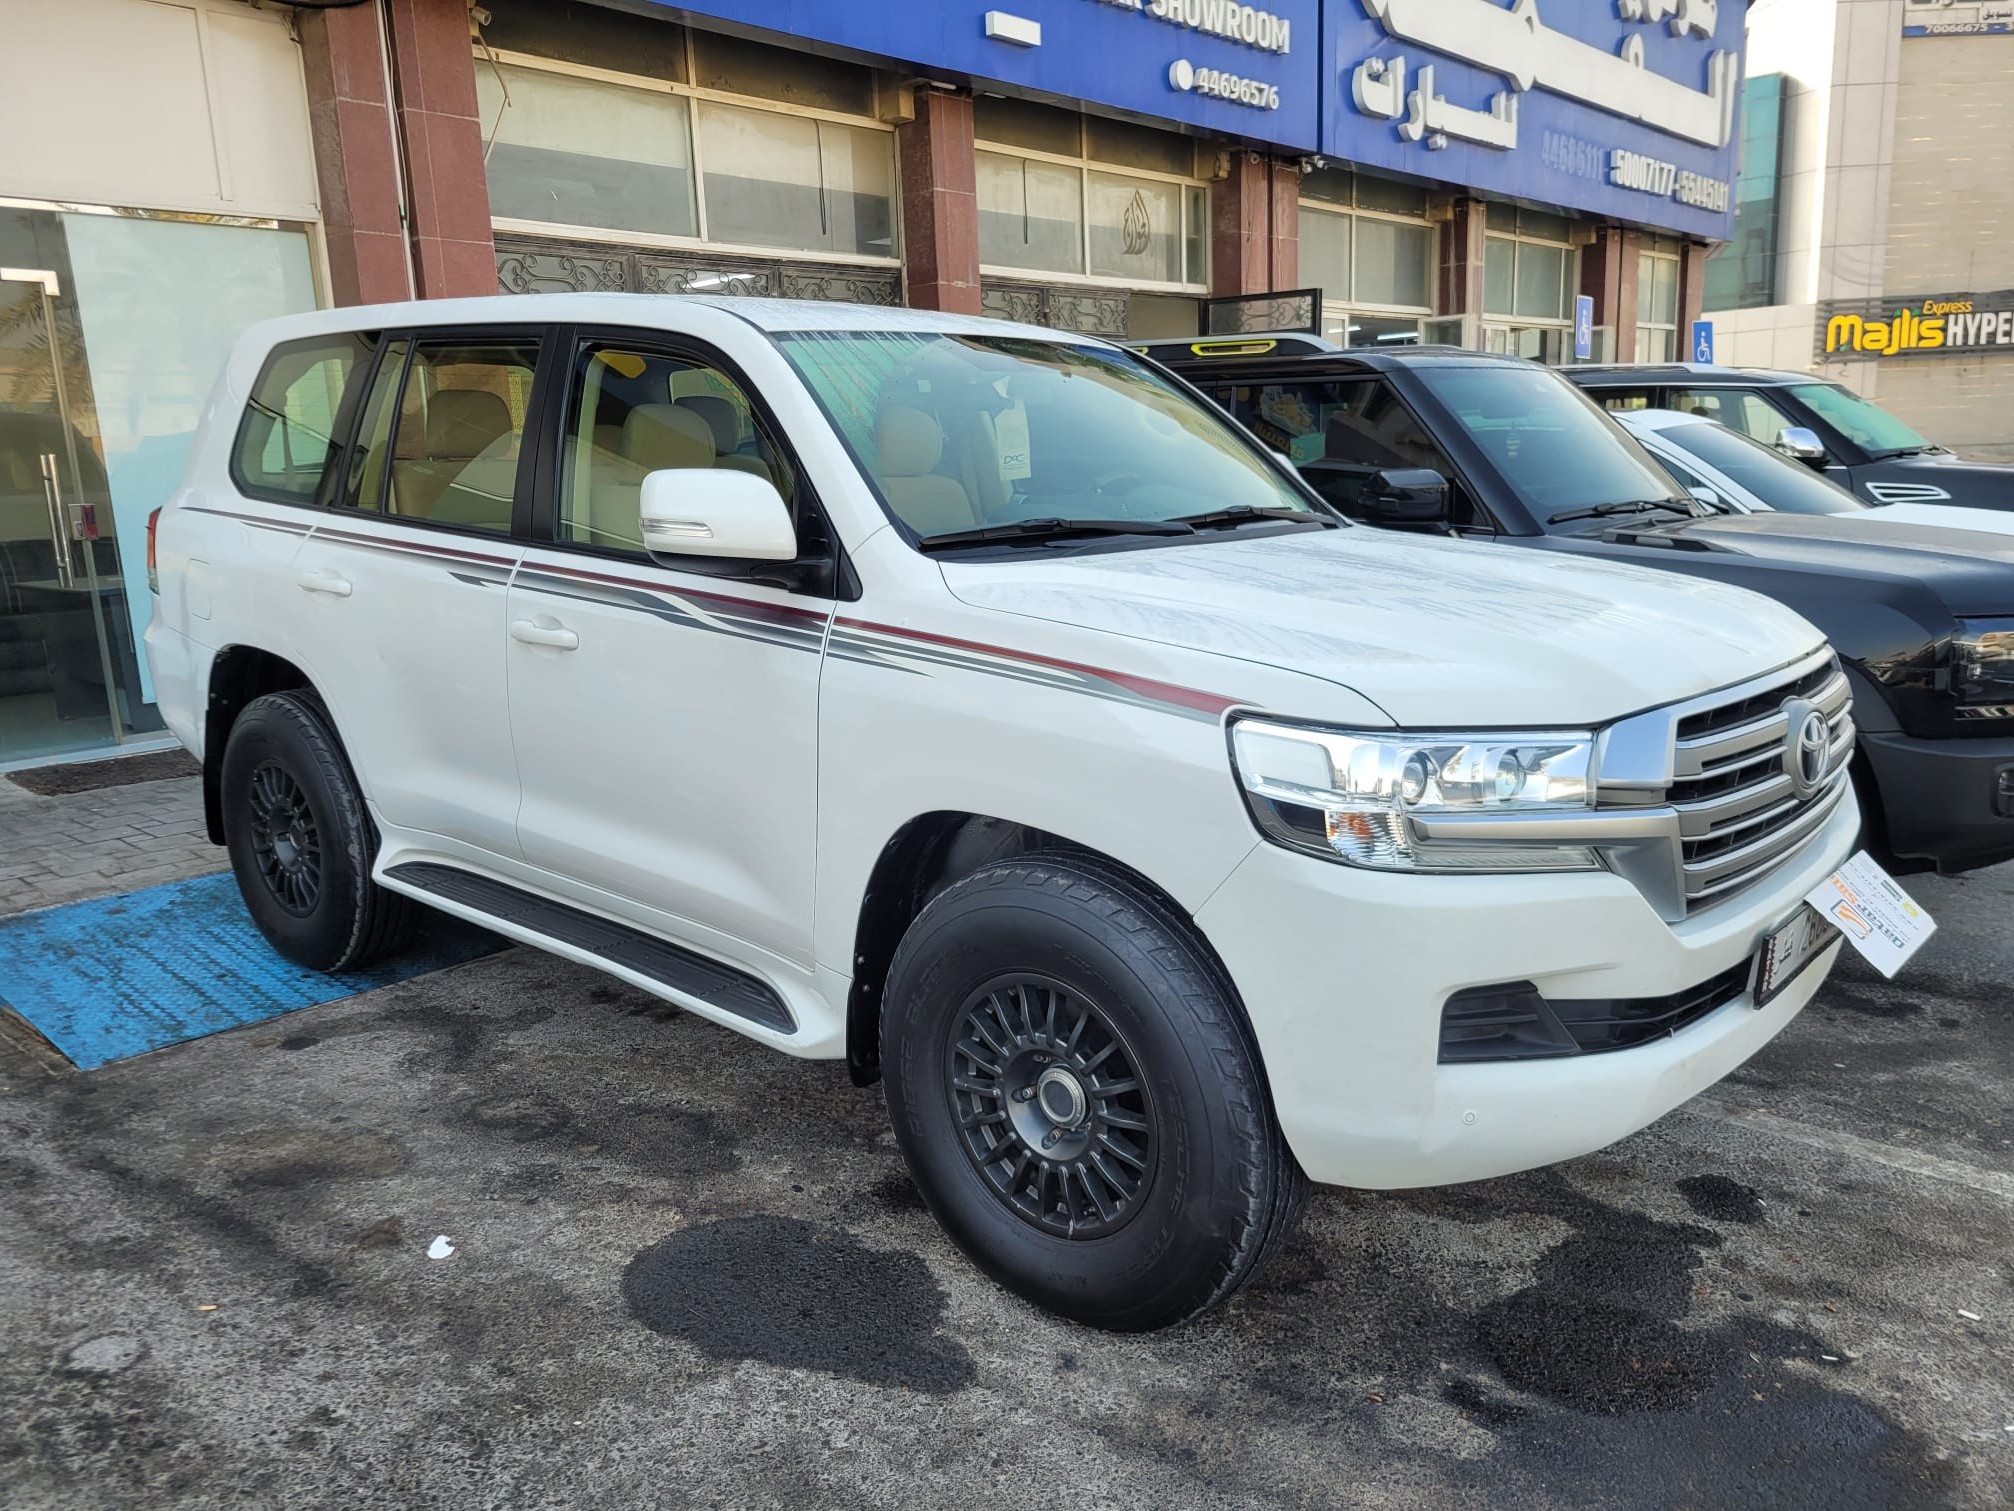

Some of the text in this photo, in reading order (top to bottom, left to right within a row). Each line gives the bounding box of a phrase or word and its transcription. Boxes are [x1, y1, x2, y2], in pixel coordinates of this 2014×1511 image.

[1197, 67, 1279, 109] 44696576
[1352, 55, 1518, 150] للسيارات
[1613, 149, 1676, 196] 50007177
[1923, 300, 1973, 315] Express
[1946, 311, 2014, 346] HYPE
